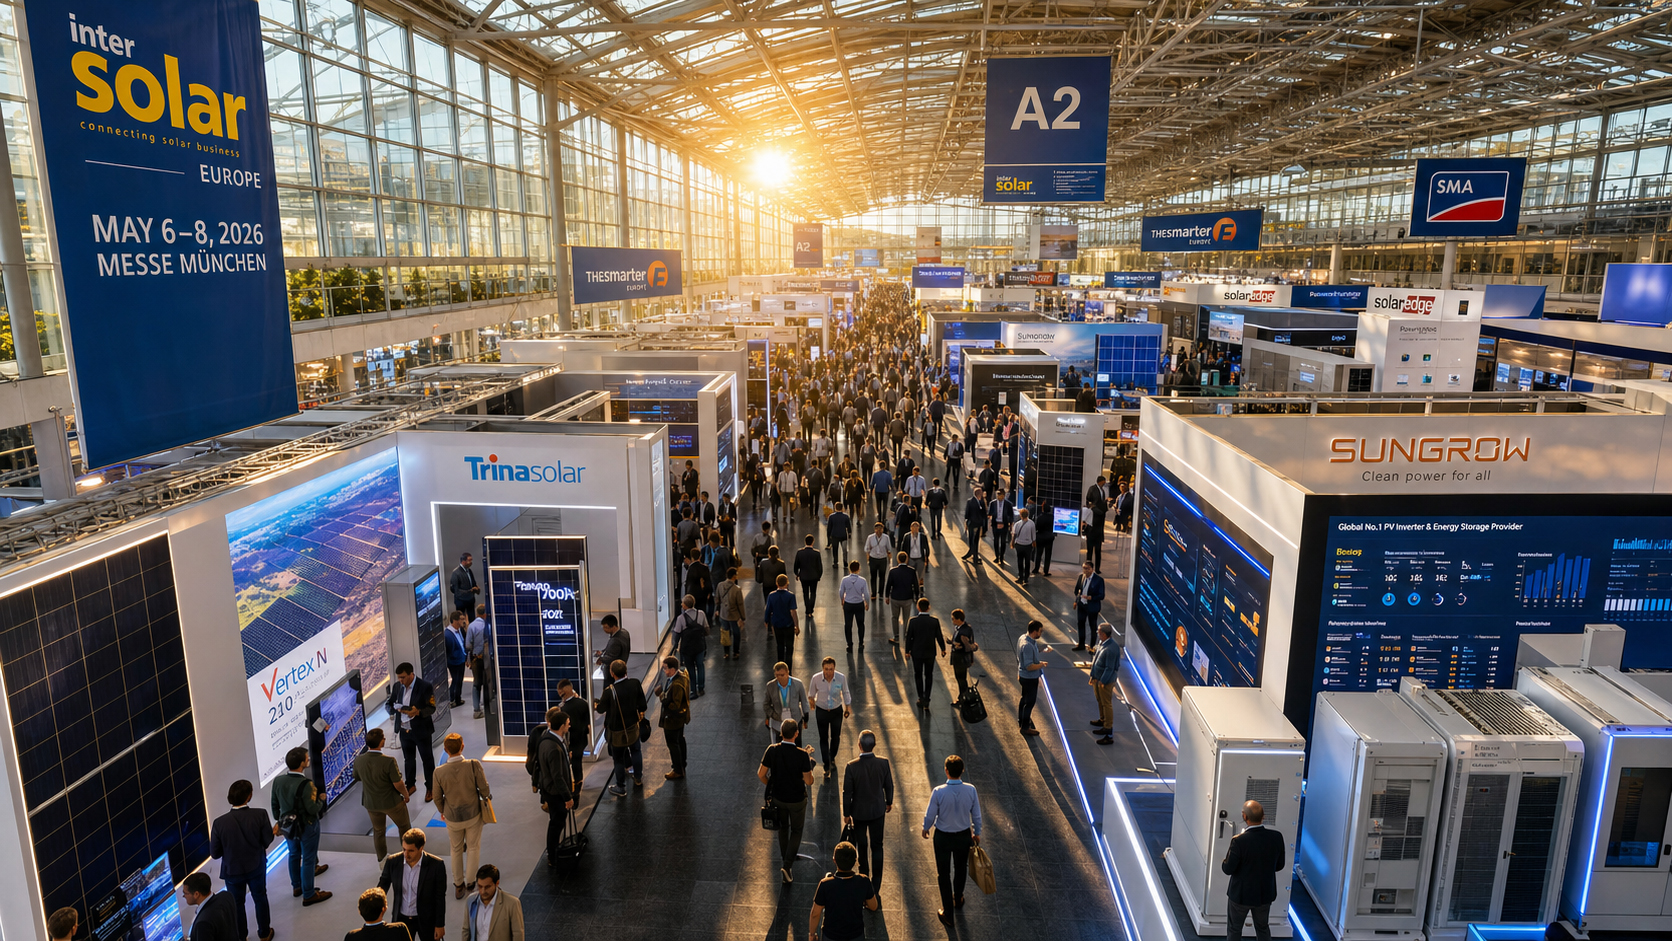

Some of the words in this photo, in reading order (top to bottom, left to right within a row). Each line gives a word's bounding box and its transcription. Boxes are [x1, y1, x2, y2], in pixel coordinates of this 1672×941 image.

[69, 12, 135, 58] inter
[71, 50, 246, 140] solar
[1010, 86, 1081, 130] A2
[80, 121, 155, 143] connecting
[162, 137, 191, 149] solar
[197, 142, 240, 158] business
[200, 163, 262, 189] EUROPE
[996, 177, 1033, 192] solar
[1436, 179, 1473, 194] SMA
[92, 214, 153, 244] MAY
[218, 221, 264, 246] 2026
[796, 242, 811, 252] A2
[97, 252, 174, 277] MESSE
[179, 249, 267, 275] MÜNCHEN
[1374, 294, 1436, 315] solaredge
[1329, 437, 1531, 463] SUNGROW
[464, 454, 586, 483] Trinasolar
[1362, 471, 1399, 482] Clean
[1405, 472, 1446, 483] power
[1452, 470, 1471, 481] for
[1475, 470, 1491, 481] all
[1338, 523, 1363, 531] Global
[1365, 523, 1382, 531] No.1
[1384, 523, 1395, 531] PV
[1396, 523, 1424, 531] Inverter
[1425, 523, 1432, 531] &
[1433, 523, 1459, 532] Energy
[1461, 523, 1489, 532] Storage
[1491, 523, 1523, 531] Provider
[261, 657, 315, 702] Vertex
[316, 647, 328, 668] N
[268, 695, 293, 725] 210
